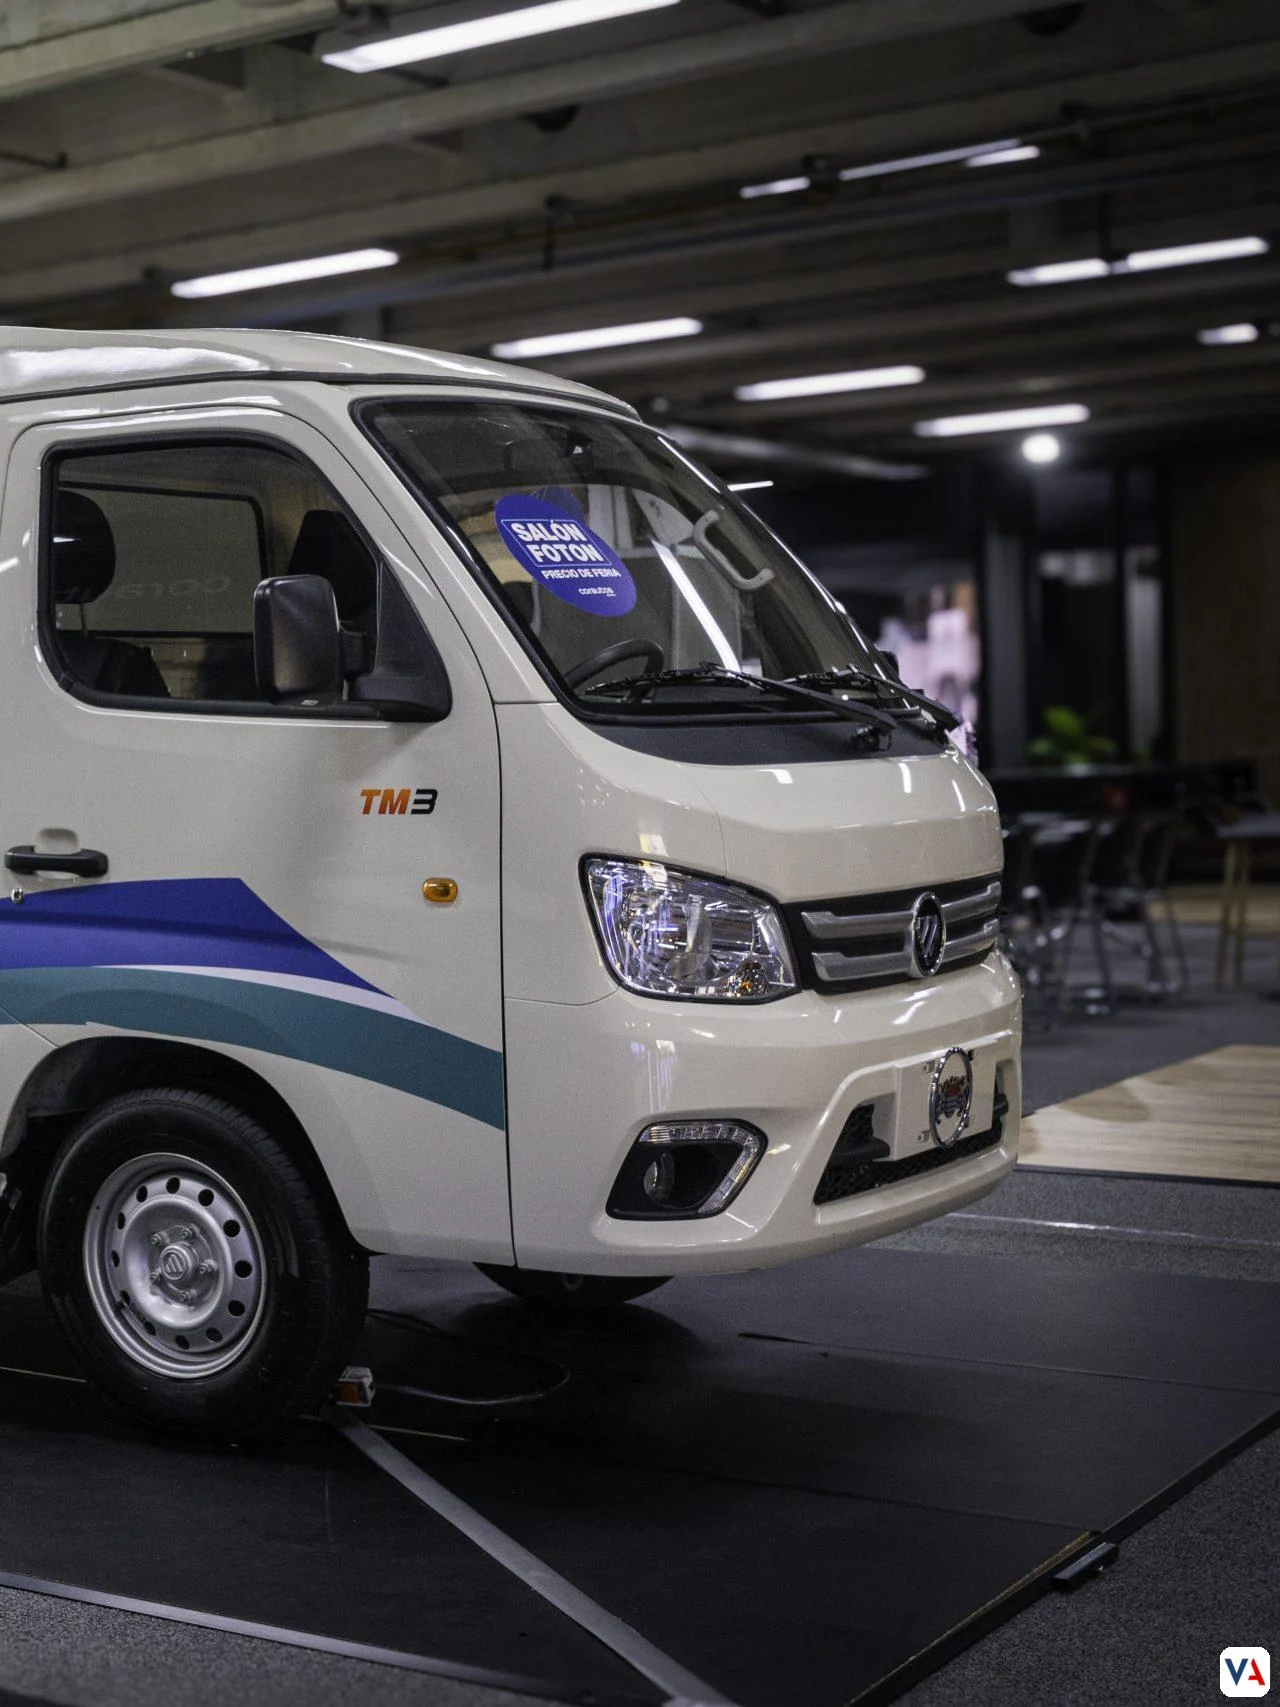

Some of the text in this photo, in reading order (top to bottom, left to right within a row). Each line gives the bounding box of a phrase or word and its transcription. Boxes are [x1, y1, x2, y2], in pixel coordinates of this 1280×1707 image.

[510, 519, 587, 542] SALÓN
[526, 544, 604, 562] FOTON
[541, 568, 621, 580] PRECIO DE FERIA
[360, 788, 438, 815] TM3
